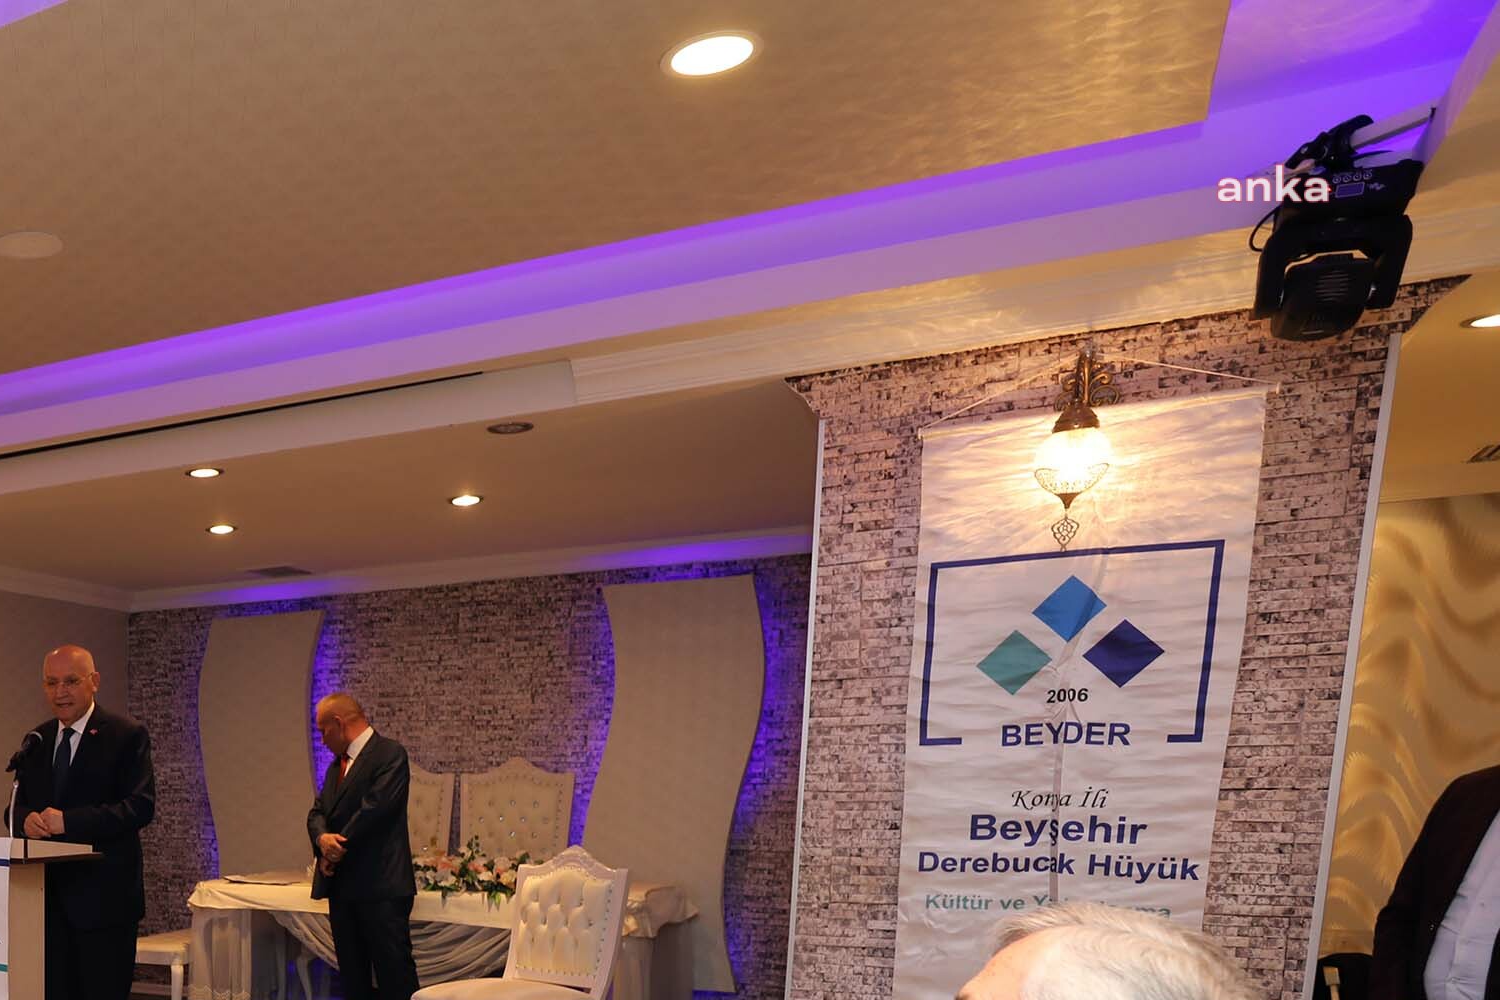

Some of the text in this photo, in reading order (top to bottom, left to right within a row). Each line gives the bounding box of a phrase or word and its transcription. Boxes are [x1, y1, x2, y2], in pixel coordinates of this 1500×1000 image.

[1046, 687, 1089, 704] 2006
[1001, 721, 1131, 748] BEYDER
[1011, 786, 1109, 812] Konya İli
[969, 814, 1148, 847] Beyşehir
[918, 851, 1200, 885] Derebucak Hüyük
[925, 893, 993, 910] Kültür
[1000, 897, 1025, 911] ve
